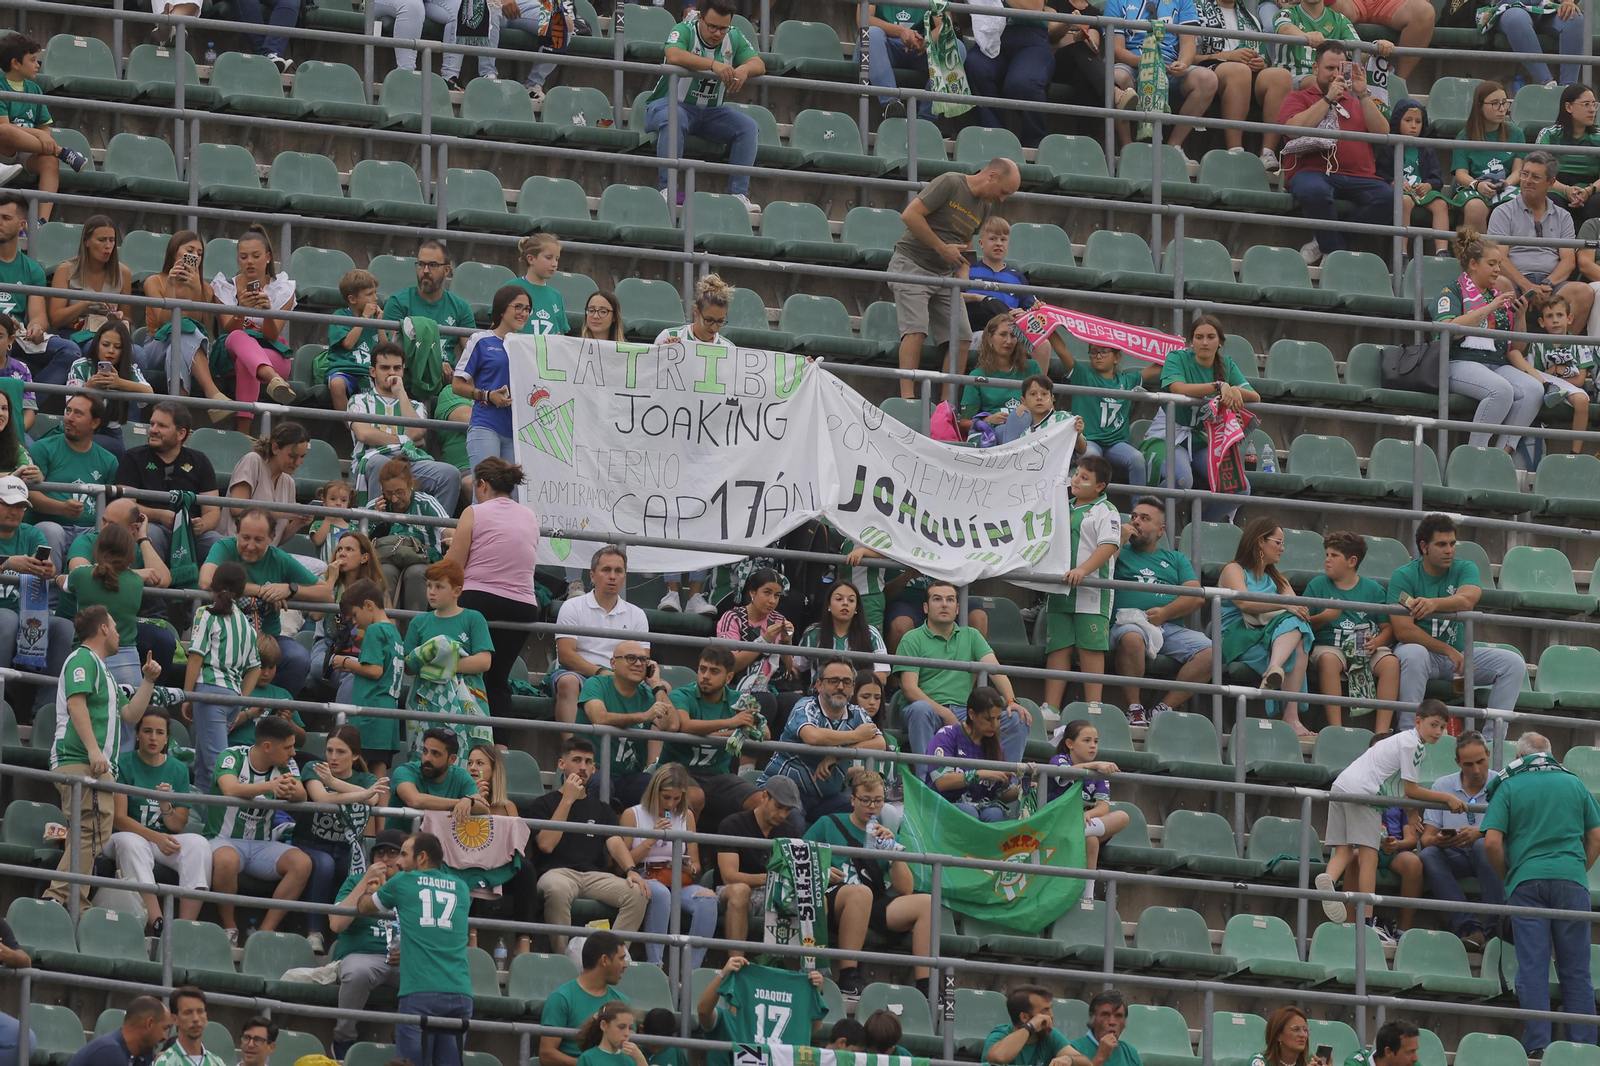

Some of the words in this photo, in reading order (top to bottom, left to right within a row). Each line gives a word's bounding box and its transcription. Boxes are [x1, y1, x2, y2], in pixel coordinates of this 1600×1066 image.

[531, 320, 554, 335] 17
[616, 341, 806, 398] TRIBU
[1100, 402, 1123, 428] 17
[575, 445, 680, 489] ETERNO
[538, 480, 615, 512] ADMIRAMOS
[837, 464, 1014, 549] JOAQUÍN
[1022, 508, 1053, 541] 17
[140, 805, 161, 826] 17
[788, 842, 816, 923] BETIS
[811, 851, 823, 908] ESTAMOS
[418, 888, 458, 930] 17
[754, 988, 793, 1003] JOAQUÍN
[754, 1003, 793, 1045] 17
